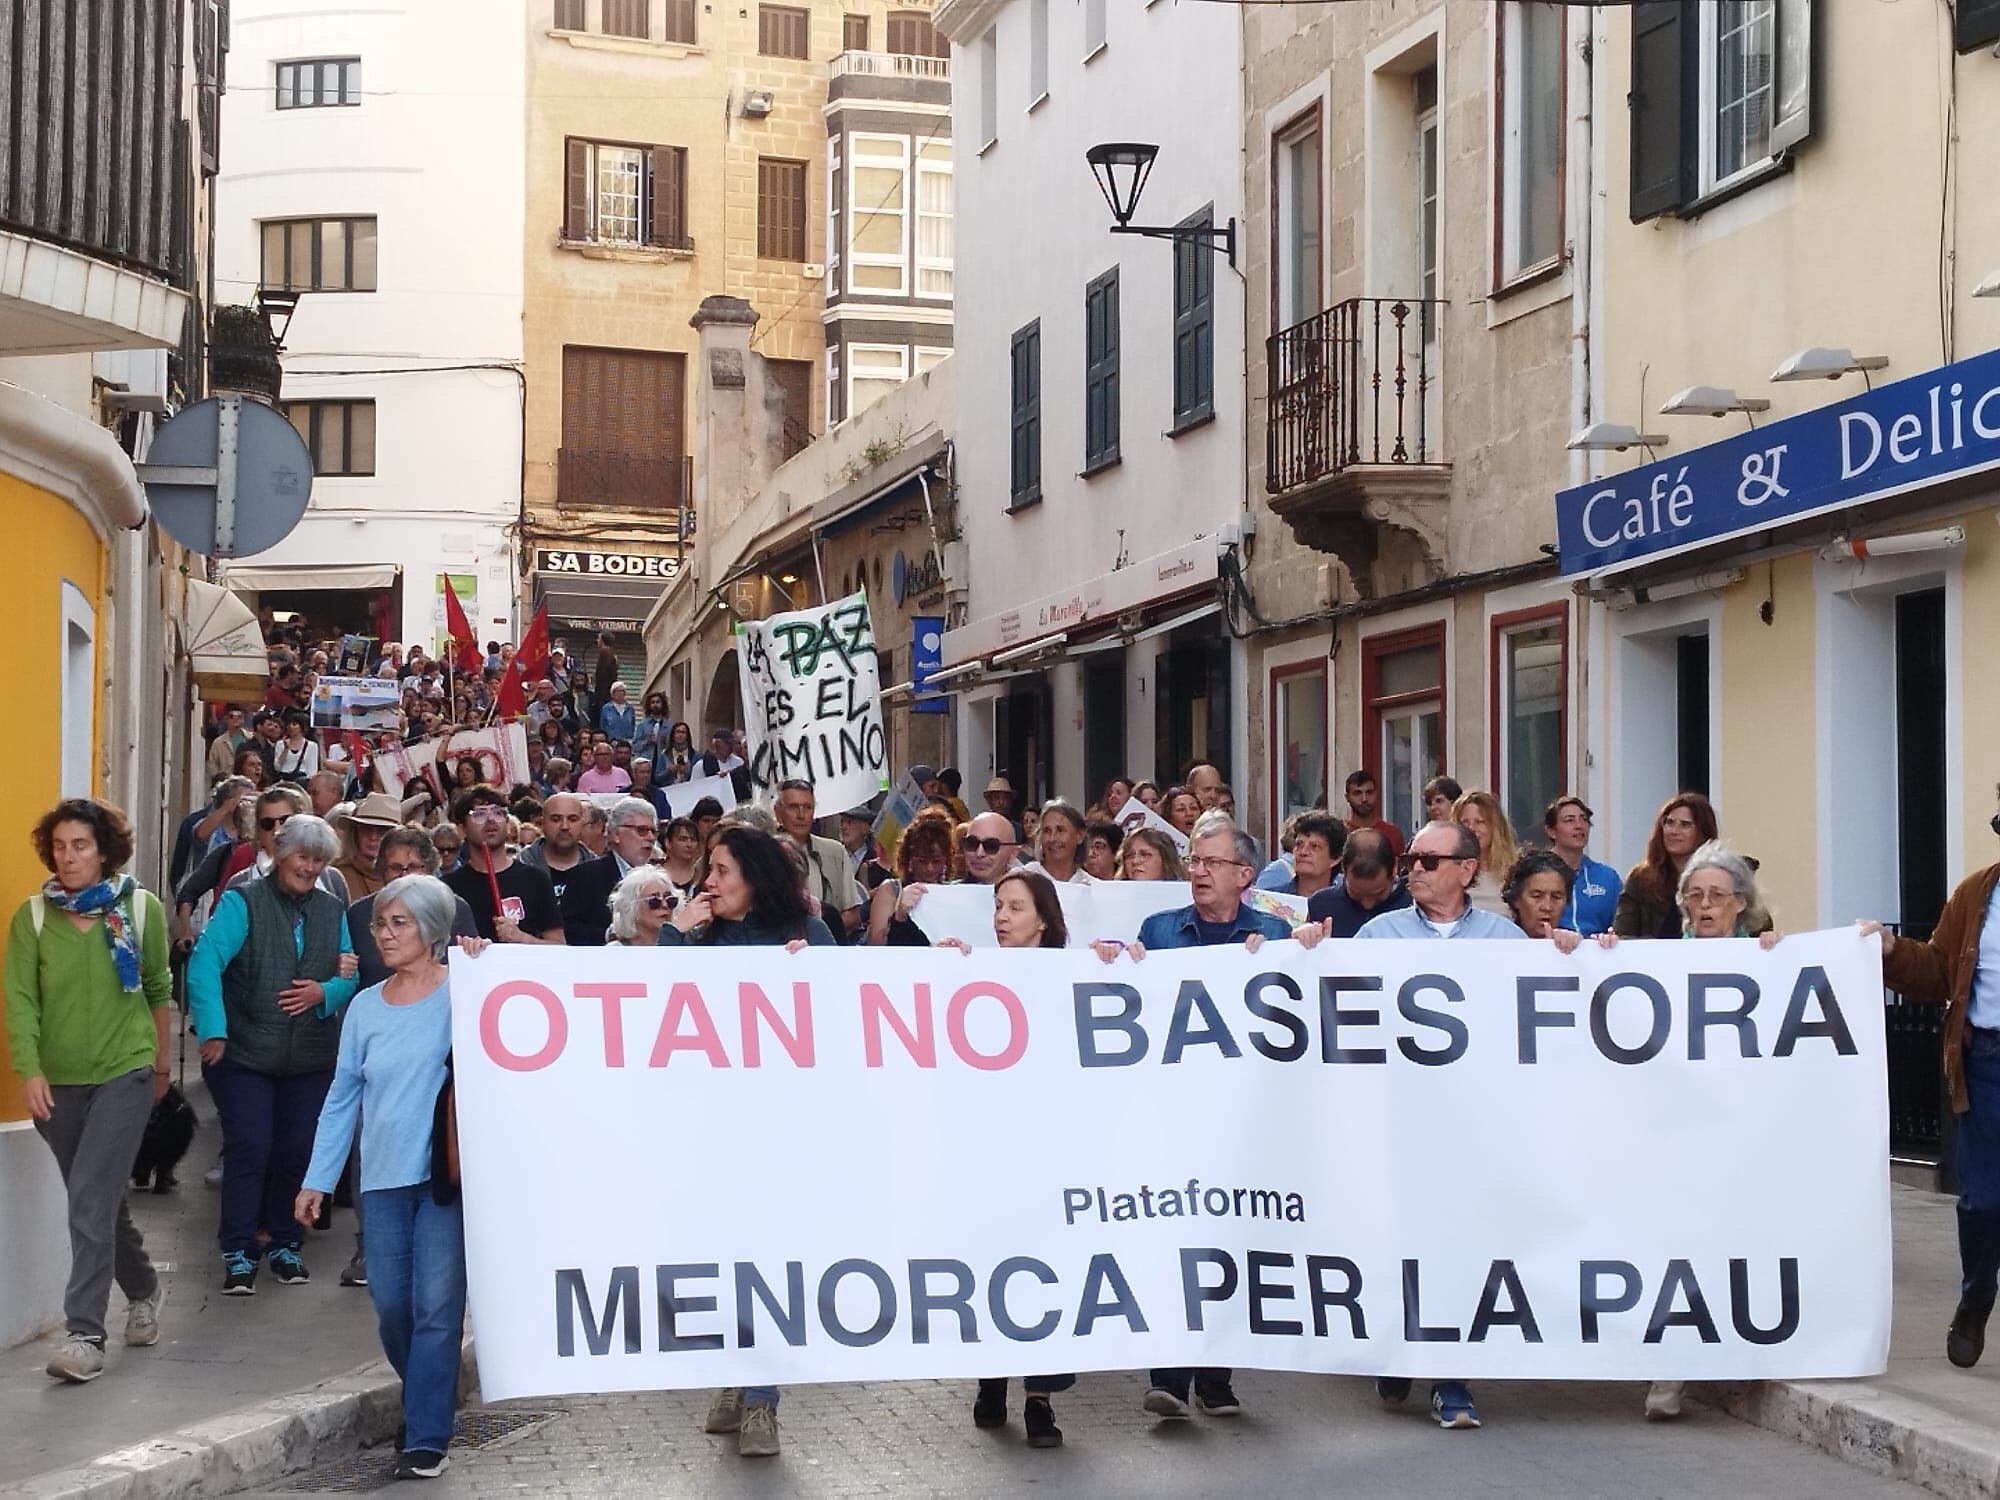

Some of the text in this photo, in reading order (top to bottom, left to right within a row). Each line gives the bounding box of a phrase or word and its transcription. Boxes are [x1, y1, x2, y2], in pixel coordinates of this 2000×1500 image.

[1582, 382, 2000, 549] Café & Delic
[547, 551, 679, 577] SA BODEG
[747, 604, 877, 686] LA PAZ
[765, 675, 871, 731] ES EL
[751, 716, 885, 788] CAMINO
[479, 965, 1860, 1072] OTAN NO BASES FORA
[1063, 1178, 1307, 1226] Plataforma
[554, 1247, 1801, 1358] MENORCA PER LA PAU
